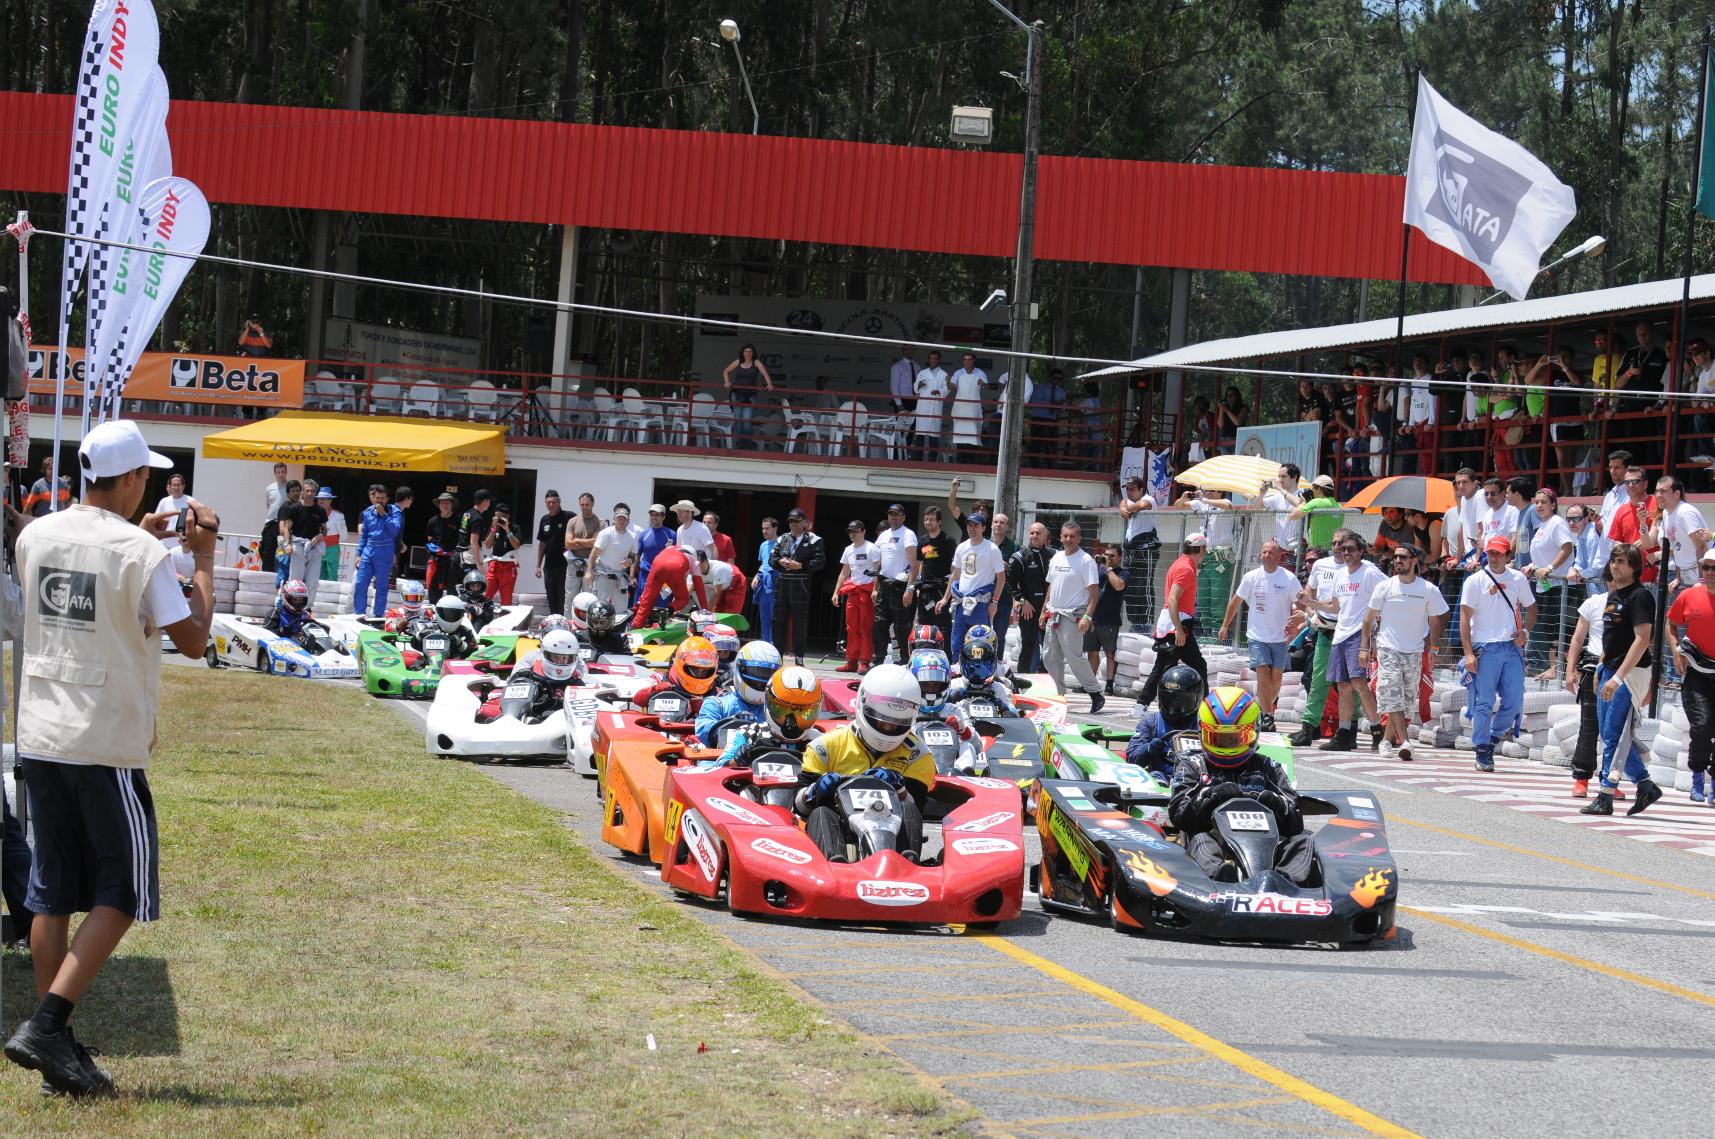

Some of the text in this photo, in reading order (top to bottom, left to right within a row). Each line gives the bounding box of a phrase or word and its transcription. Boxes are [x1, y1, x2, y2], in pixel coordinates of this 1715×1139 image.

[99, 0, 130, 158] EURO INDY
[143, 188, 182, 301] INDY EURO
[201, 360, 280, 393] Beta
[242, 451, 409, 469] www.postronix.pt
[40, 572, 93, 614] GATA
[854, 790, 884, 800] 74
[1054, 806, 1086, 866] WARNING
[860, 883, 927, 898] liztrez
